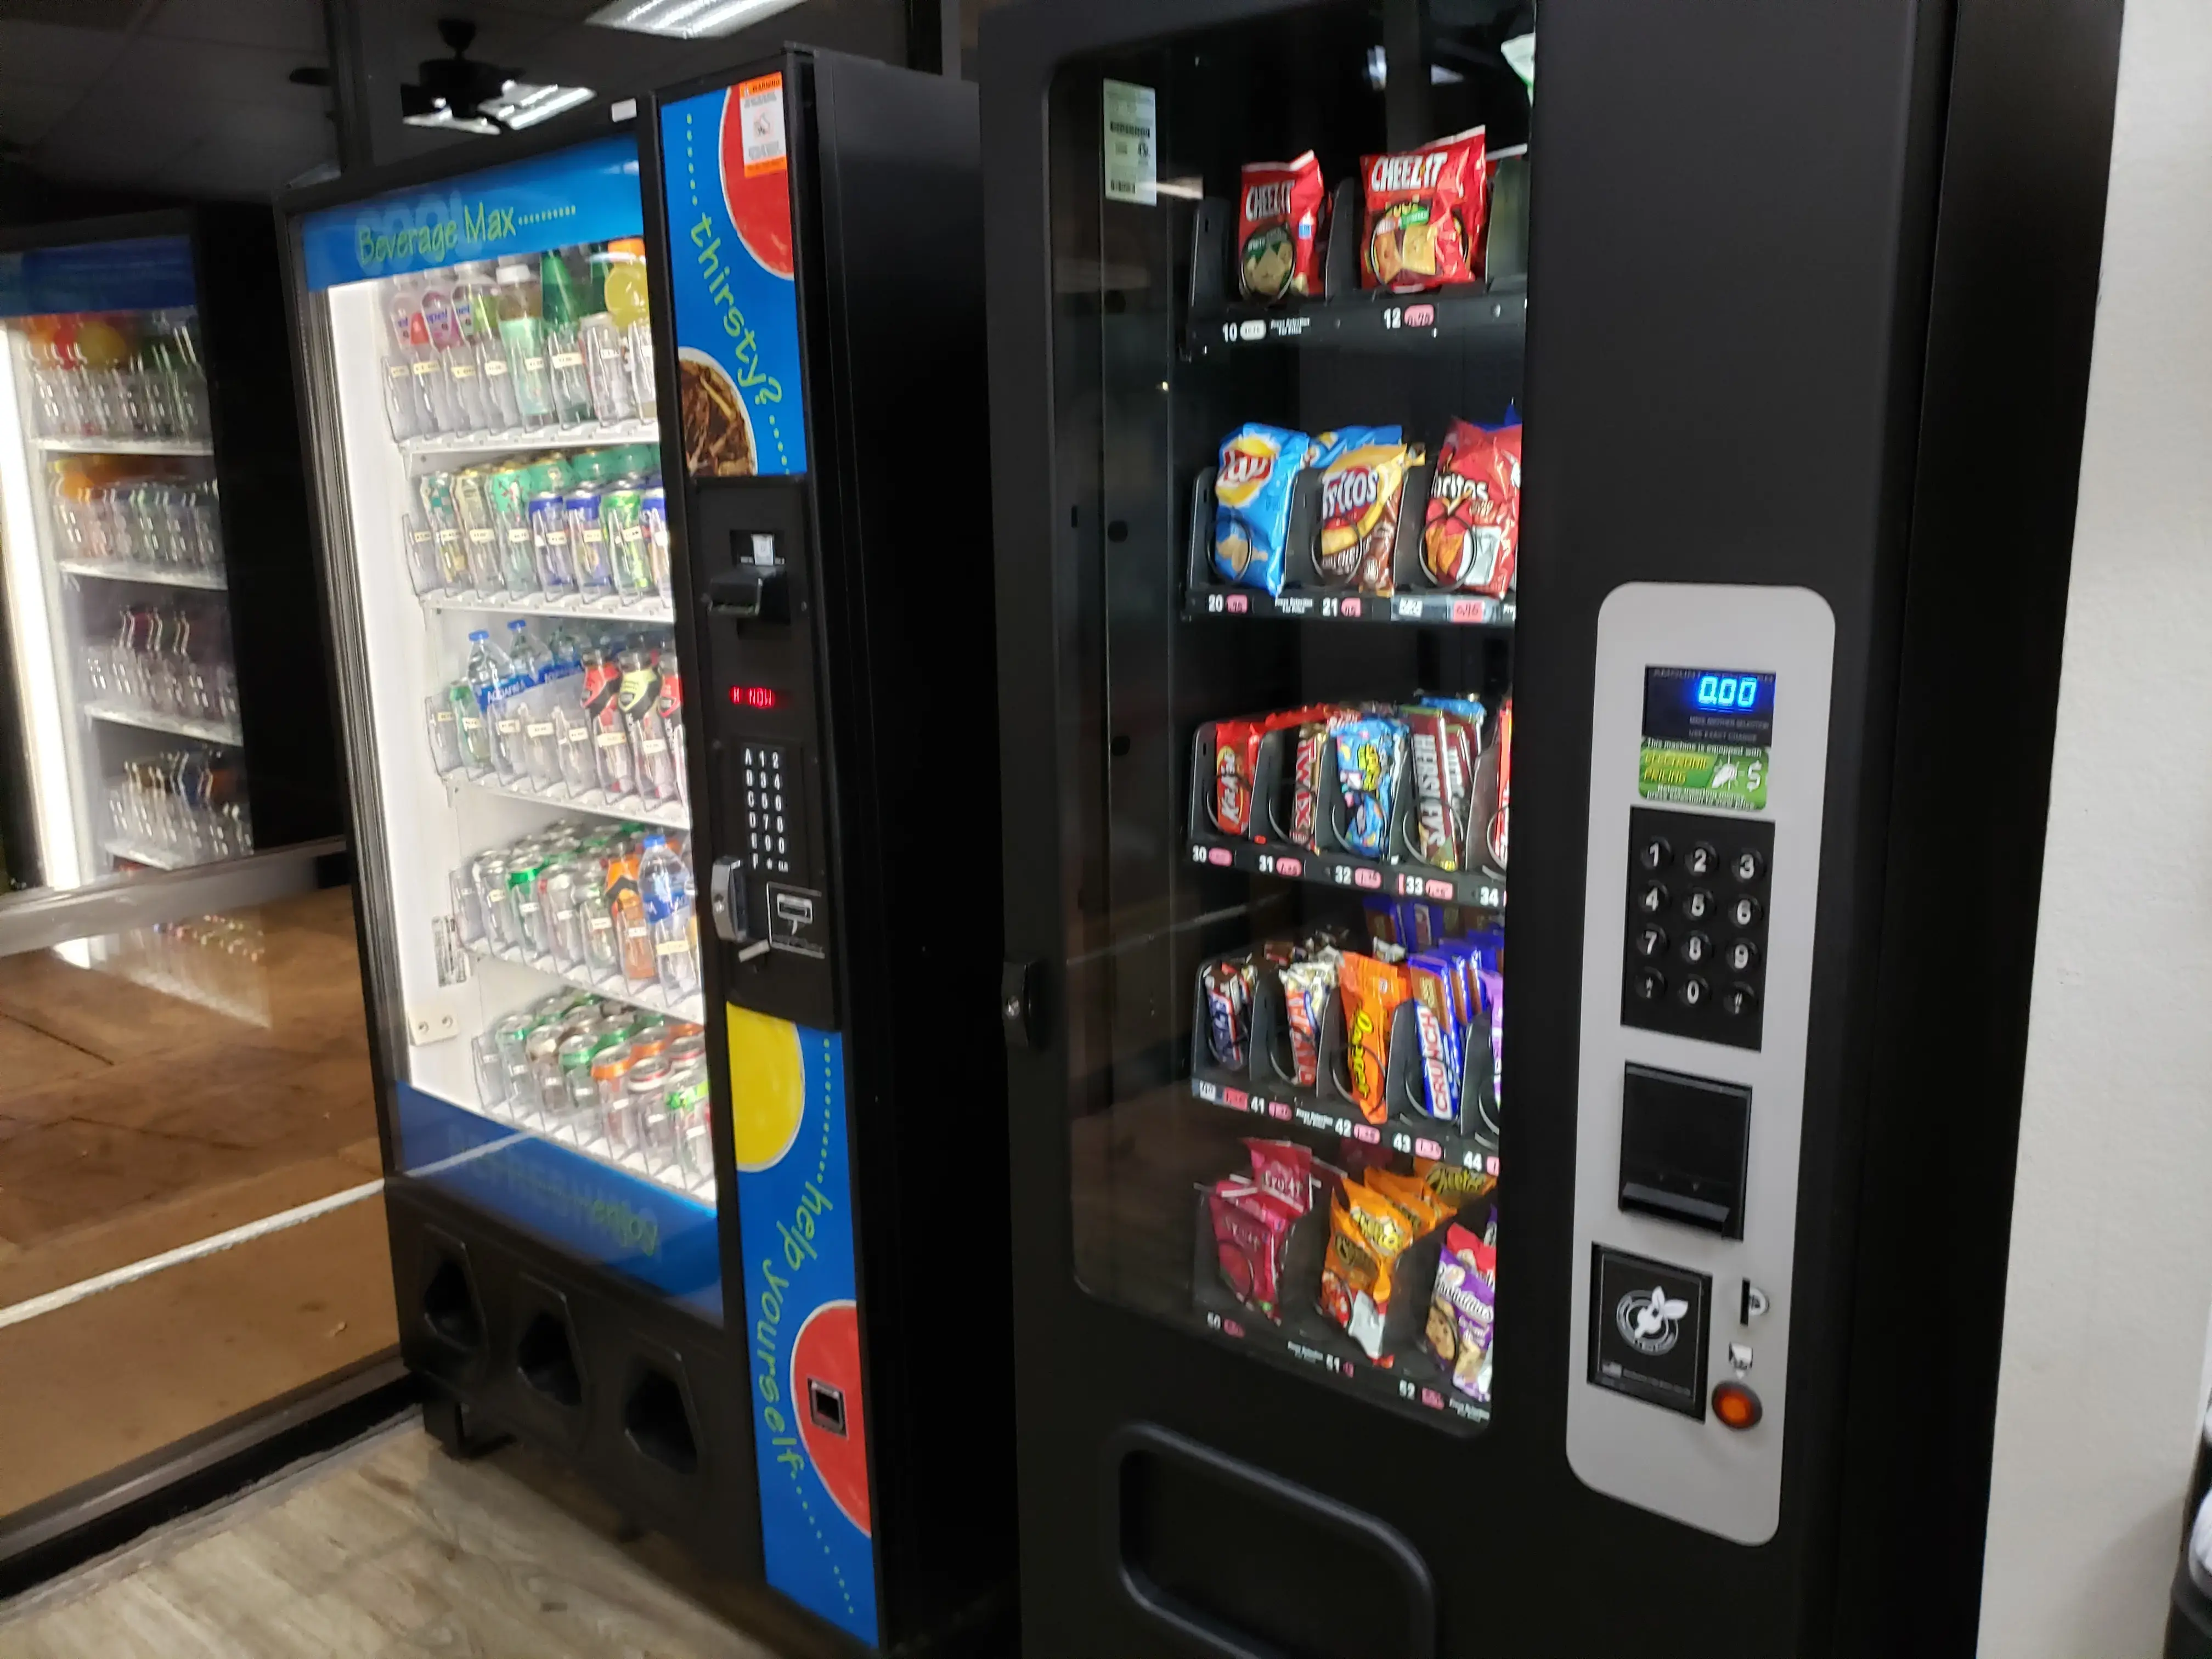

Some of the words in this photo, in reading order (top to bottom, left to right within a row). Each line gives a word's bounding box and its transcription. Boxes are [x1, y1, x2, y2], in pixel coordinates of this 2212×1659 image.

[359, 220, 458, 266] Beverage
[465, 200, 516, 244] Max
[690, 212, 782, 405] thirsty?
[1384, 307, 1401, 330] 12
[1222, 322, 1237, 342] 10
[1208, 594, 1223, 613] 20
[1323, 597, 1338, 617] 21
[1192, 845, 1207, 863] 30
[1259, 855, 1273, 873] 31
[1650, 843, 1660, 867] 1
[1694, 848, 1707, 872] 2
[1740, 854, 1754, 879] 3
[1335, 865, 1351, 885] 32
[1406, 876, 1423, 895] 33
[1480, 886, 1499, 906] 34
[1645, 888, 1658, 911] 4
[1645, 930, 1657, 955] 7
[1687, 980, 1700, 1005] 0
[1419, 1011, 1449, 1113] CRUNCH
[1250, 1096, 1265, 1113] 41
[1335, 1118, 1351, 1137] 42
[1393, 1132, 1411, 1153] 43
[1464, 1151, 1482, 1171] 44
[776, 1181, 833, 1271] help
[757, 1259, 804, 1471] yourself
